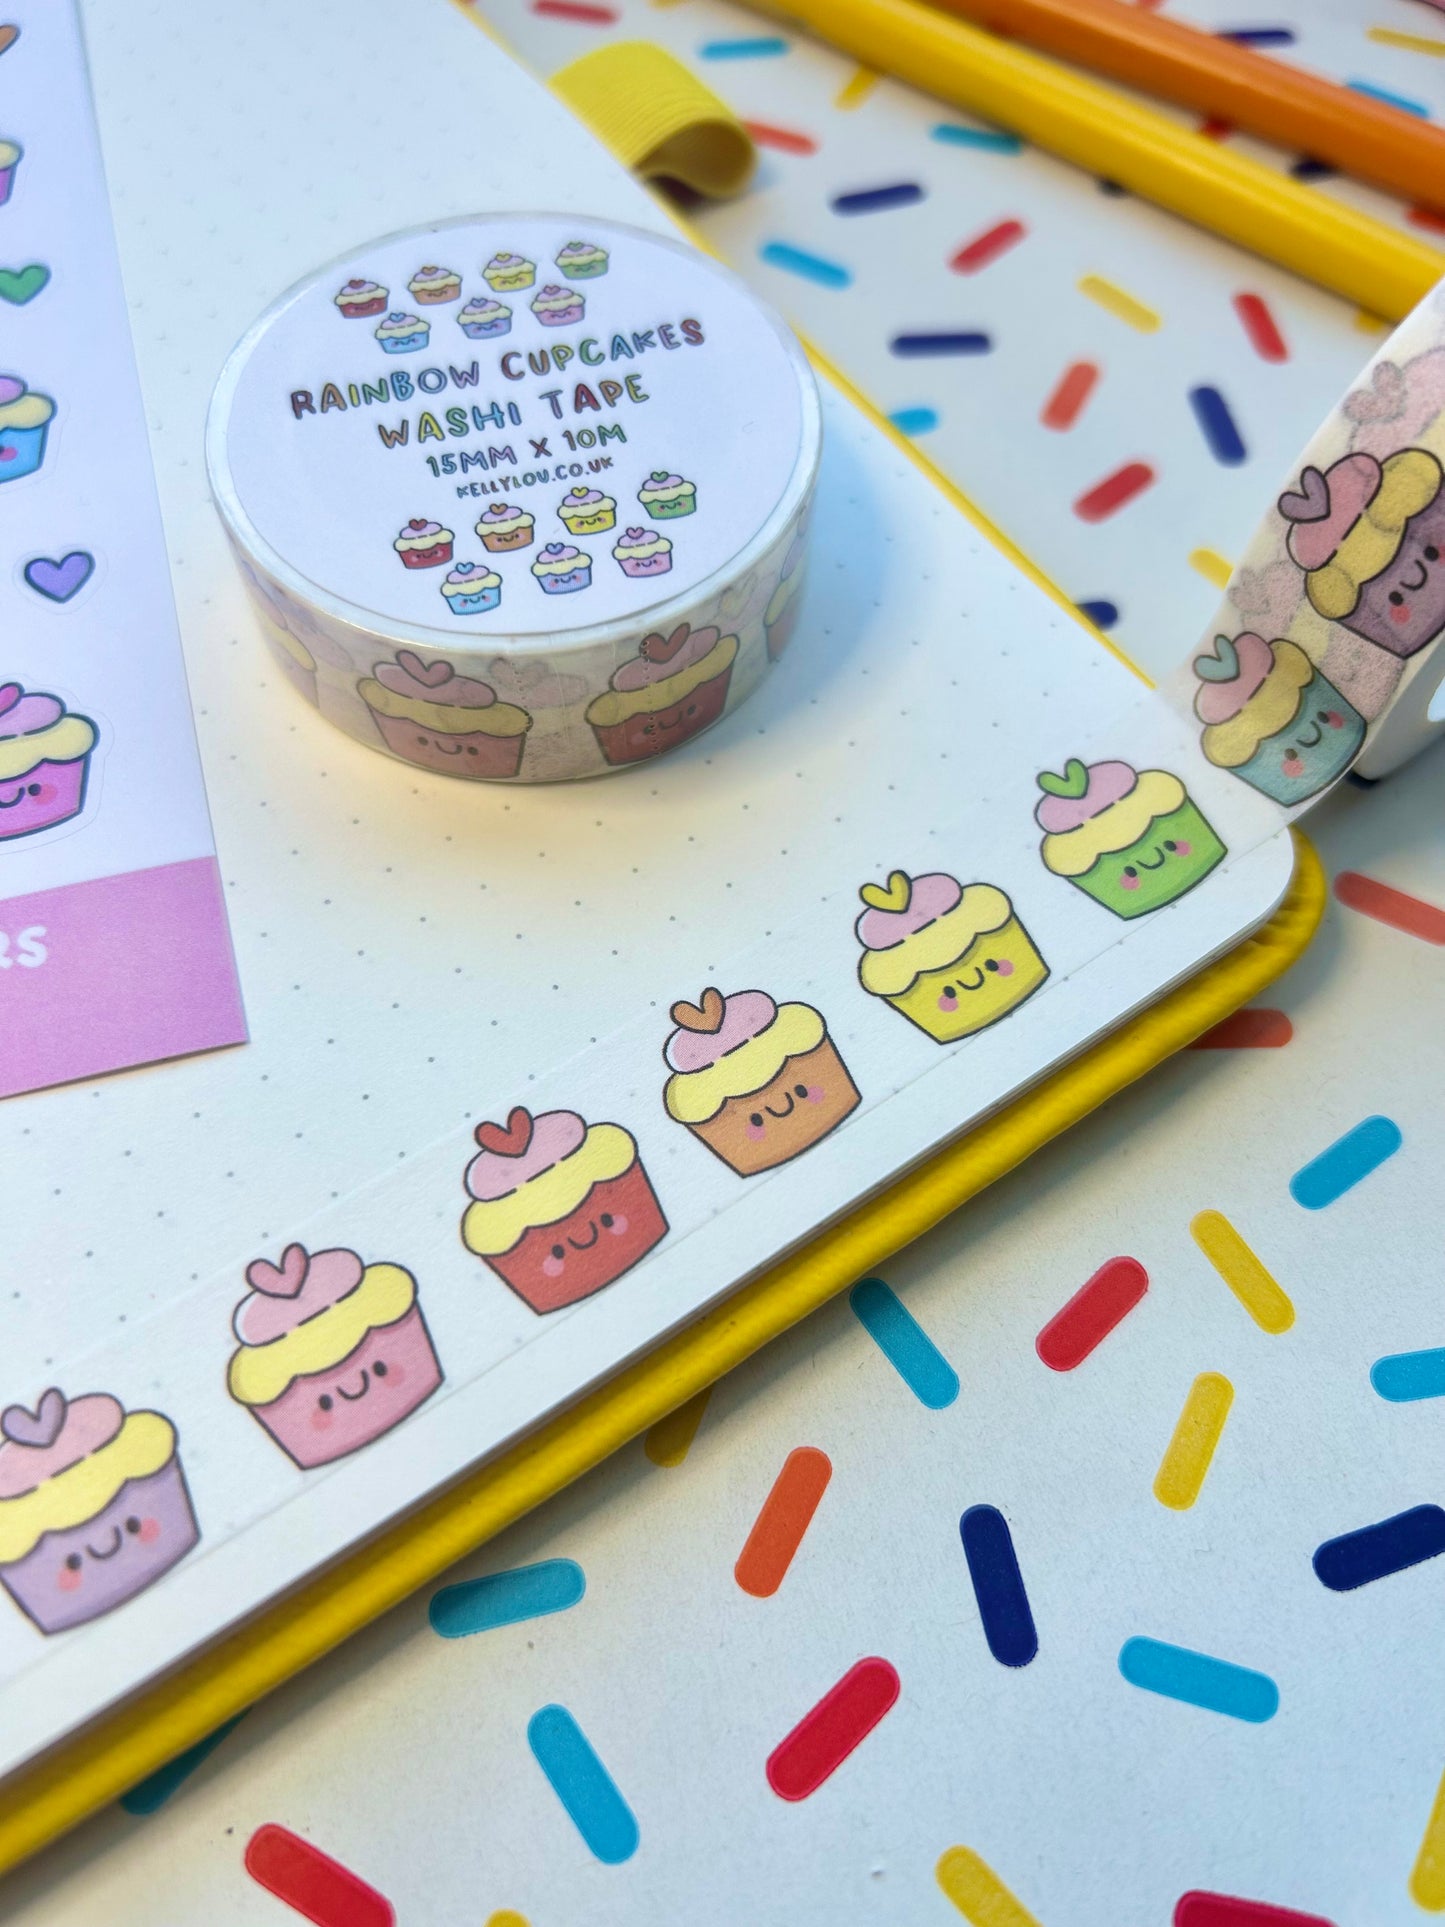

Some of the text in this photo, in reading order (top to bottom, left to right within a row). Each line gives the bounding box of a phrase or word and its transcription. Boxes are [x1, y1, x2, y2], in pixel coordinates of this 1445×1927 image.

[290, 319, 705, 420] RAINBOW CUPCAKES
[378, 374, 650, 449] WASHI TAPE
[426, 423, 628, 478] 15MM X 10M
[457, 456, 614, 499] KELLYLOU.CO.UK
